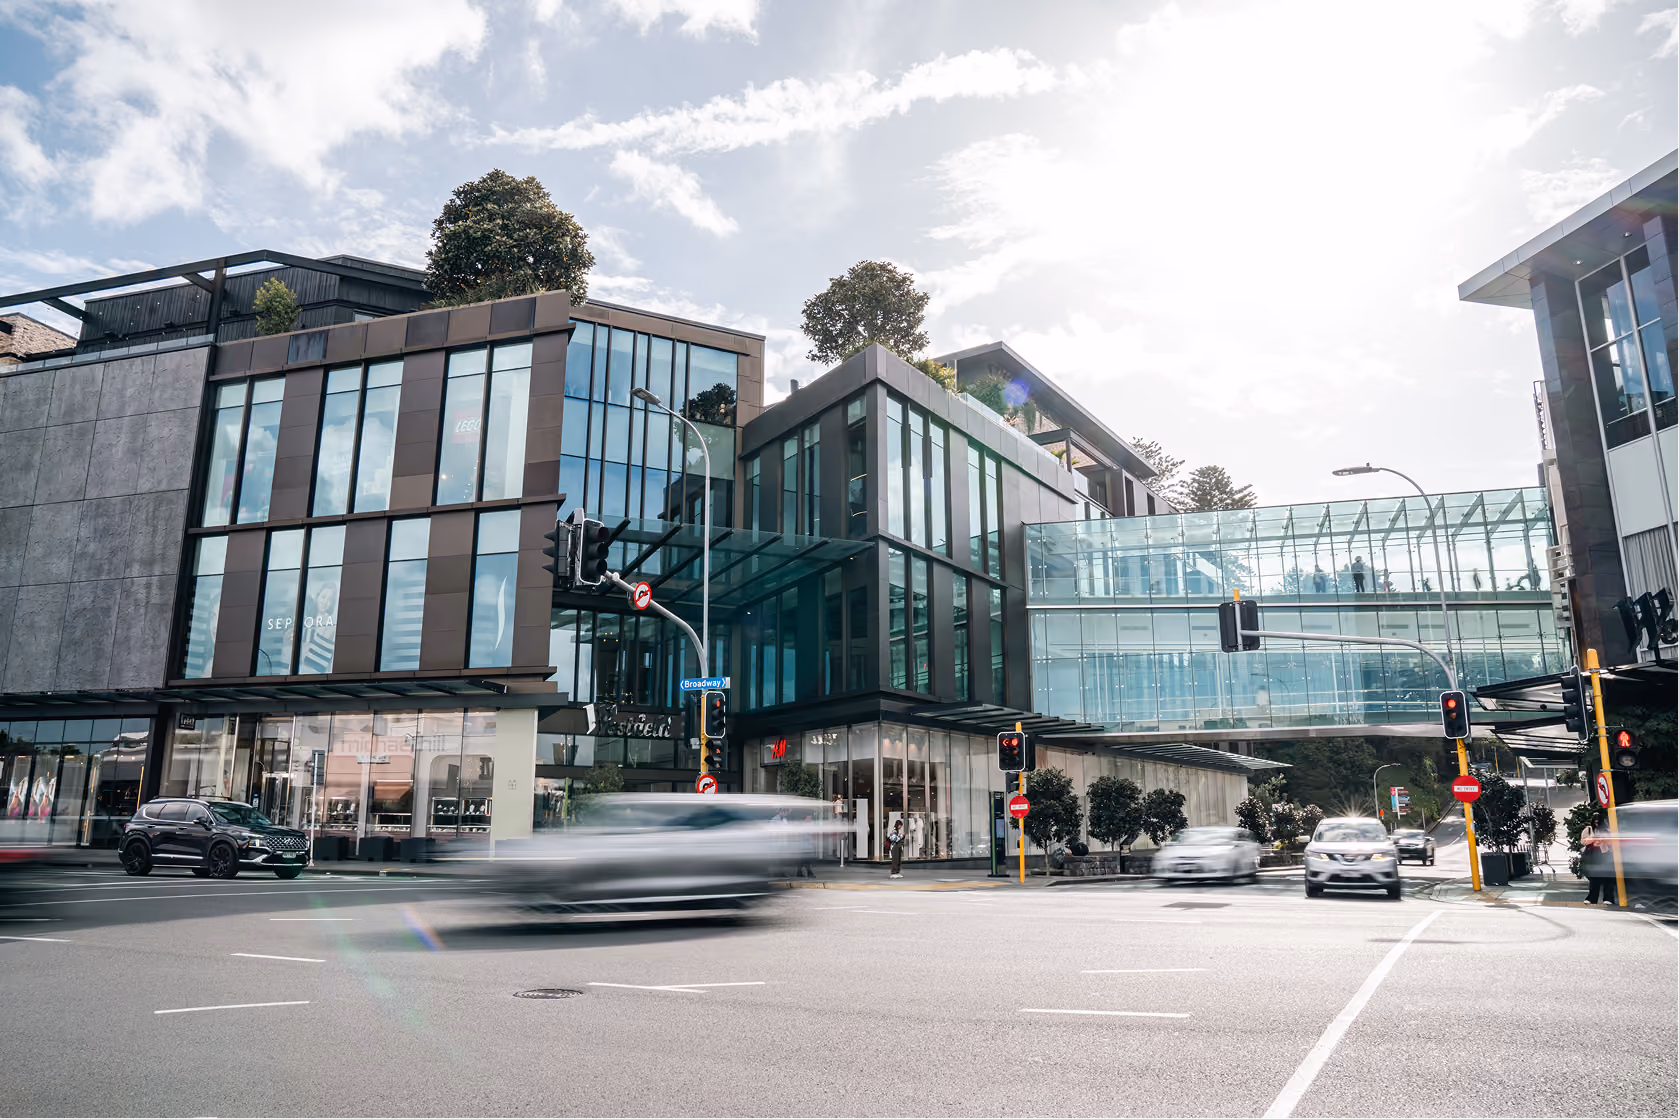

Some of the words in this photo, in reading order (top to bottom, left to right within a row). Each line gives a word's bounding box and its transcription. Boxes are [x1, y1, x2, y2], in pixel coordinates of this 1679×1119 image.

[456, 419, 481, 433] LEGO
[267, 615, 334, 630] SEPORA
[684, 680, 721, 688] Broadway
